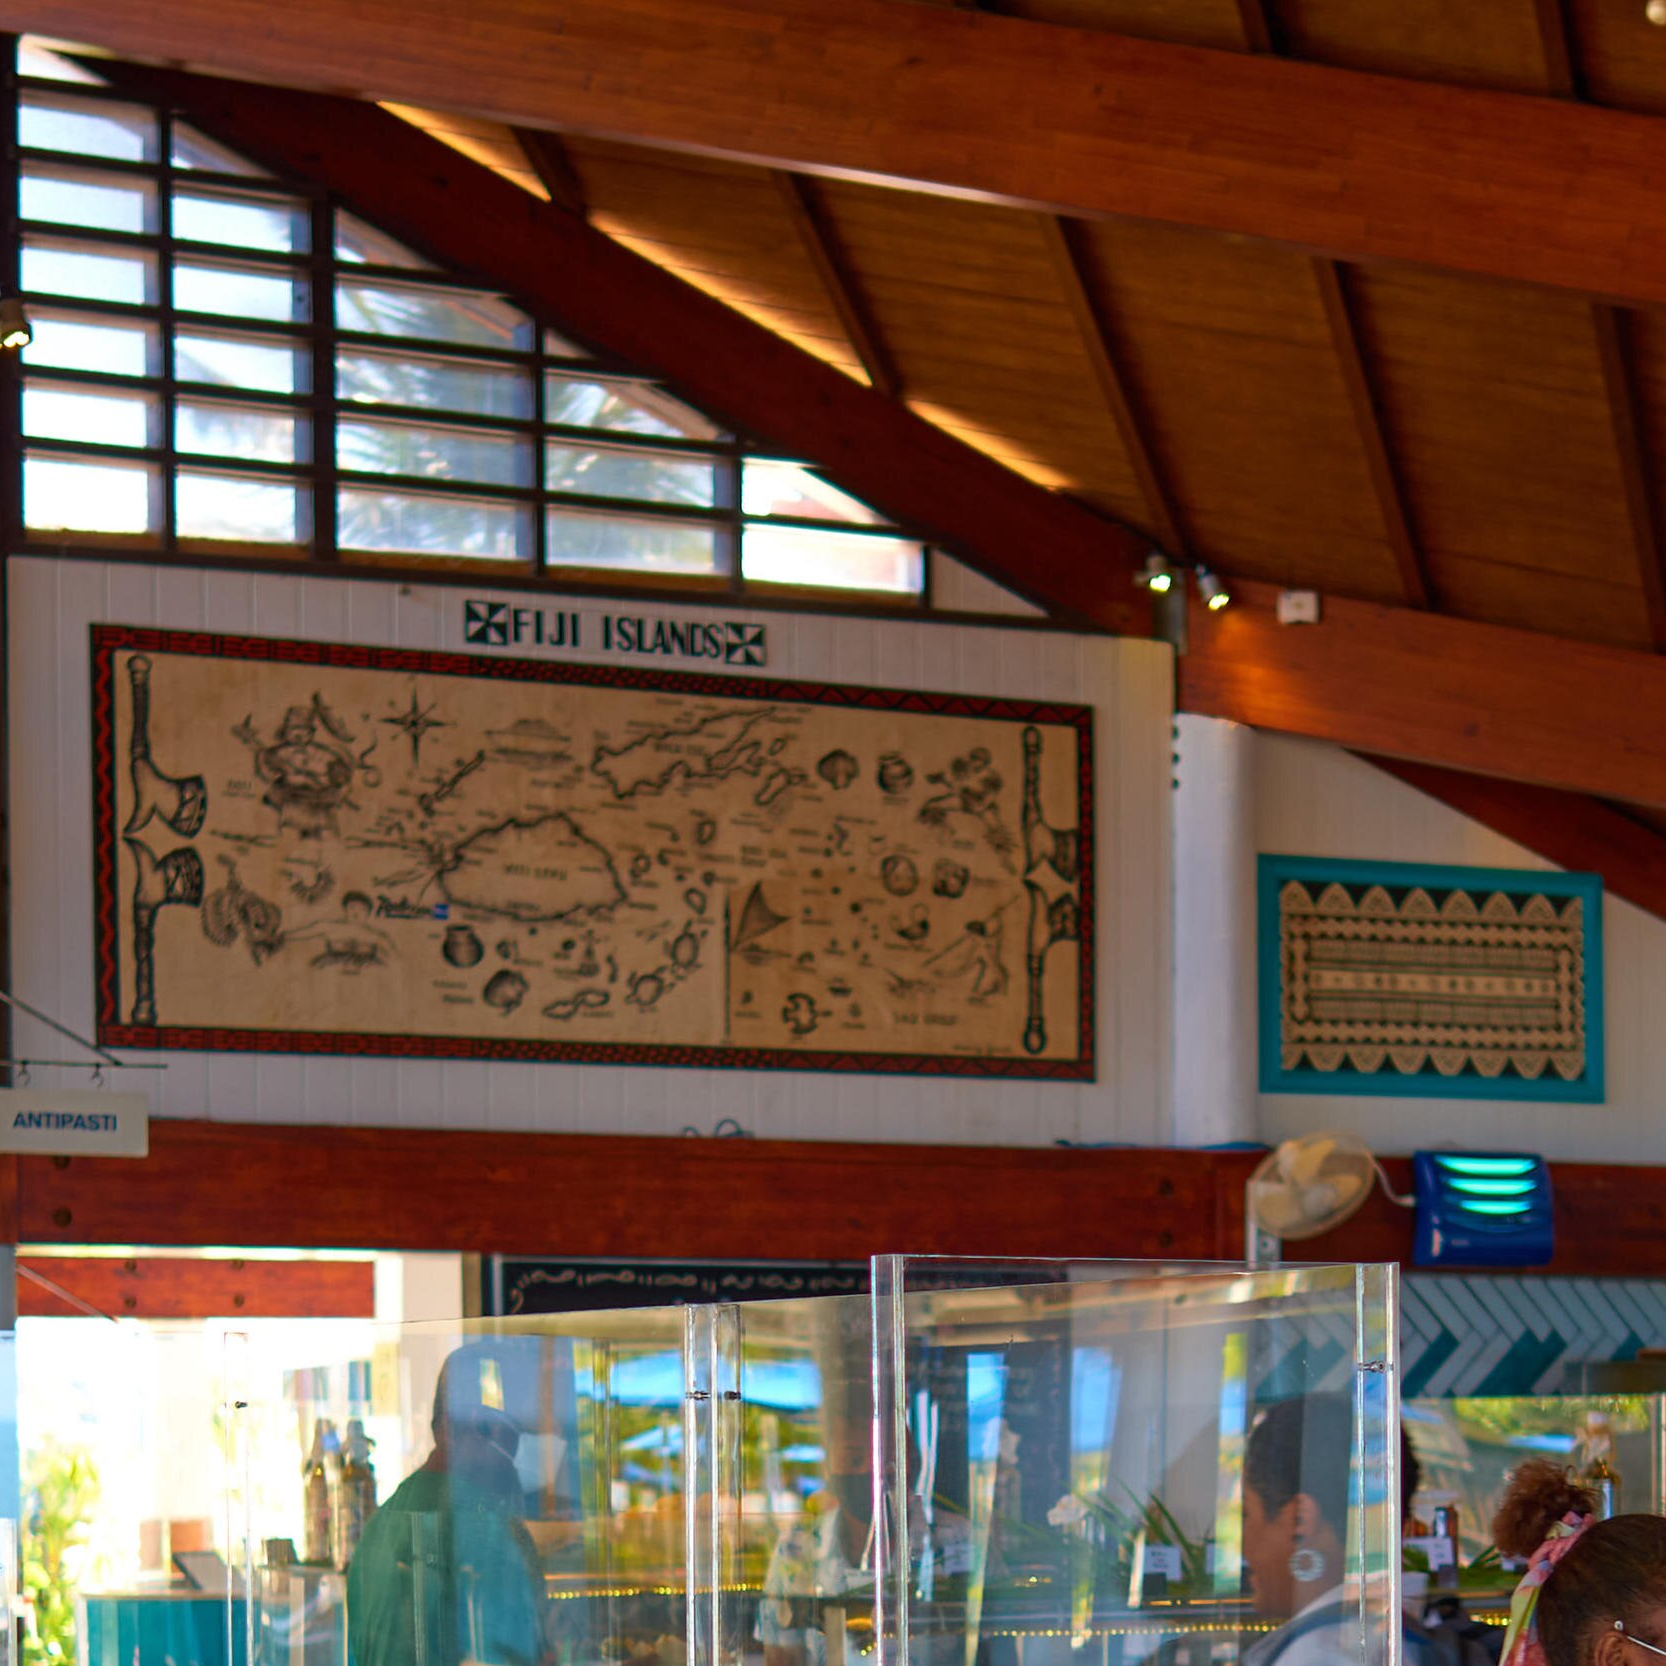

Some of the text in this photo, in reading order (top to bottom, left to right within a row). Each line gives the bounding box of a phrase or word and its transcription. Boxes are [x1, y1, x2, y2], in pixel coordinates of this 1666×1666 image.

[513, 610, 721, 659] FIJI ISLANDS
[13, 1111, 117, 1131] ANTIPASTI
